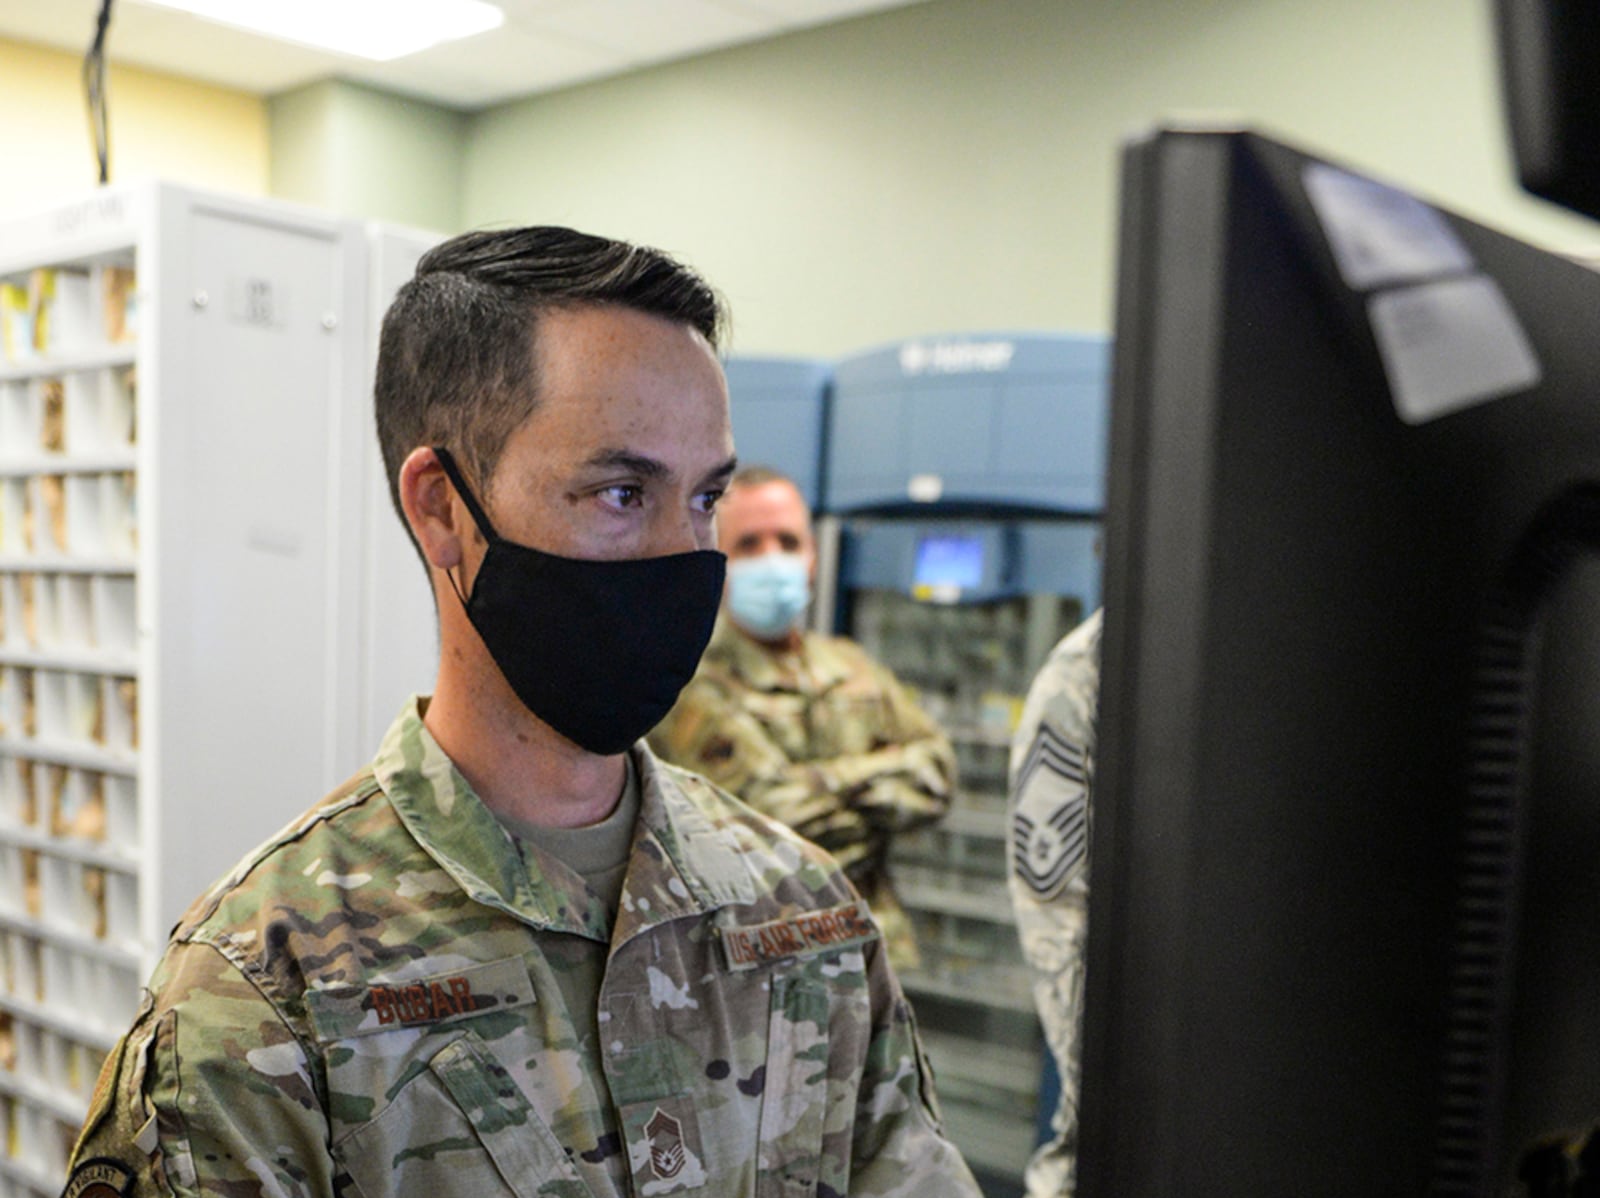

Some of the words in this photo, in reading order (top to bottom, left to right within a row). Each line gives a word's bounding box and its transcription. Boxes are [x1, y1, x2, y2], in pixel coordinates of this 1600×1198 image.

[758, 921, 803, 960] AIR
[796, 905, 872, 950] FORCE
[370, 976, 476, 1024] BUBAR
